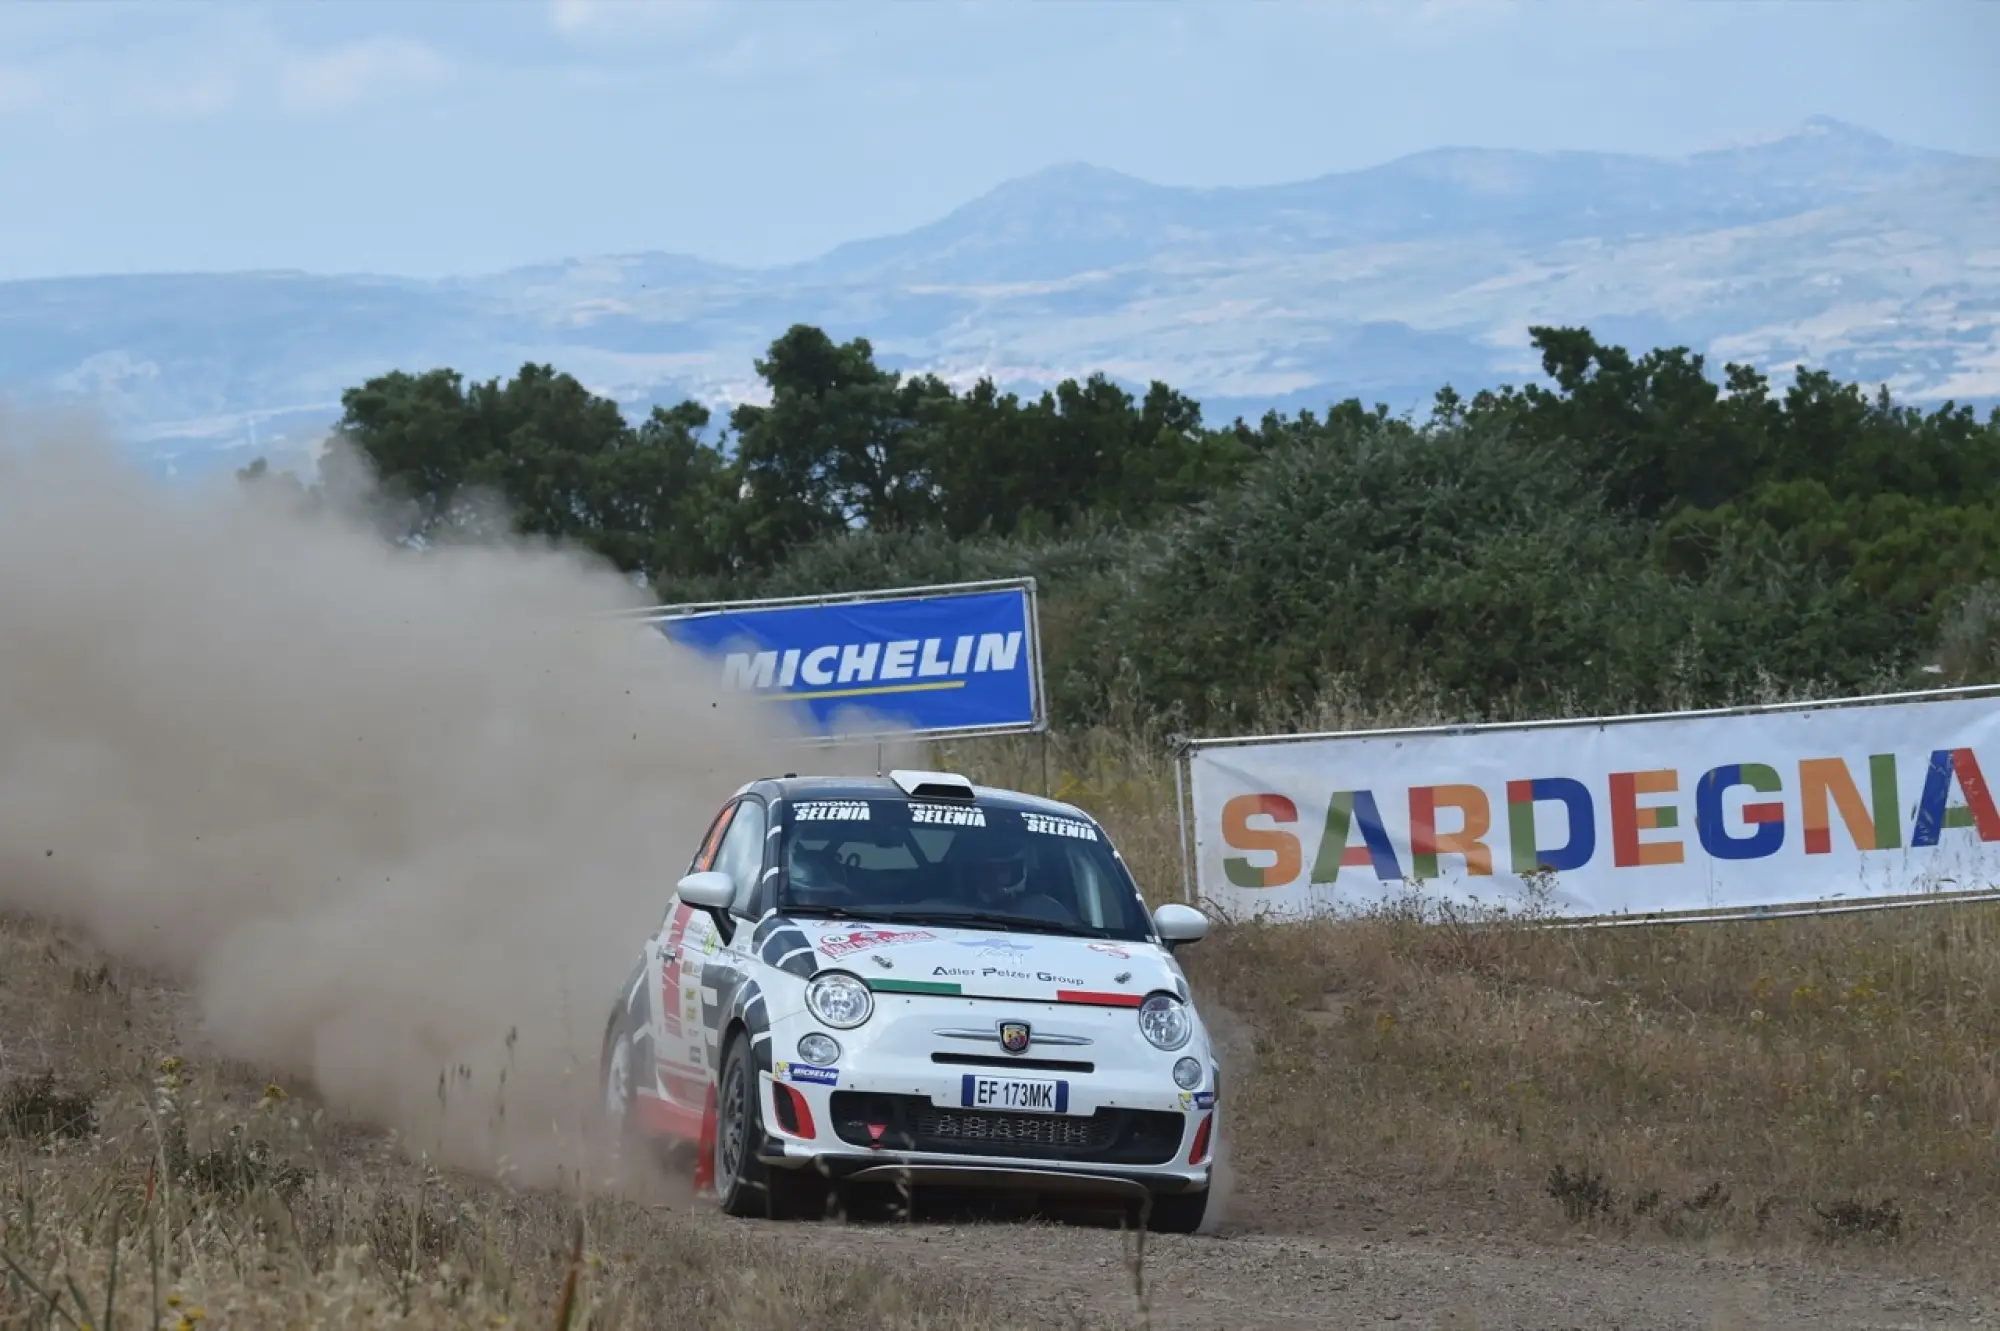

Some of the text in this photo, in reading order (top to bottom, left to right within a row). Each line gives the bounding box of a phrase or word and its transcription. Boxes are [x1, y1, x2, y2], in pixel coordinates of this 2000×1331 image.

[720, 631, 1022, 690] MICHELIN
[795, 807, 870, 821] SELENIA
[912, 809, 987, 827] SELENIA
[1221, 747, 2000, 888] SARDEGNA
[1027, 819, 1098, 841] SELENIA
[932, 966, 1084, 985] Adler Pelzer Group
[978, 1080, 1052, 1107] EF 173MK
